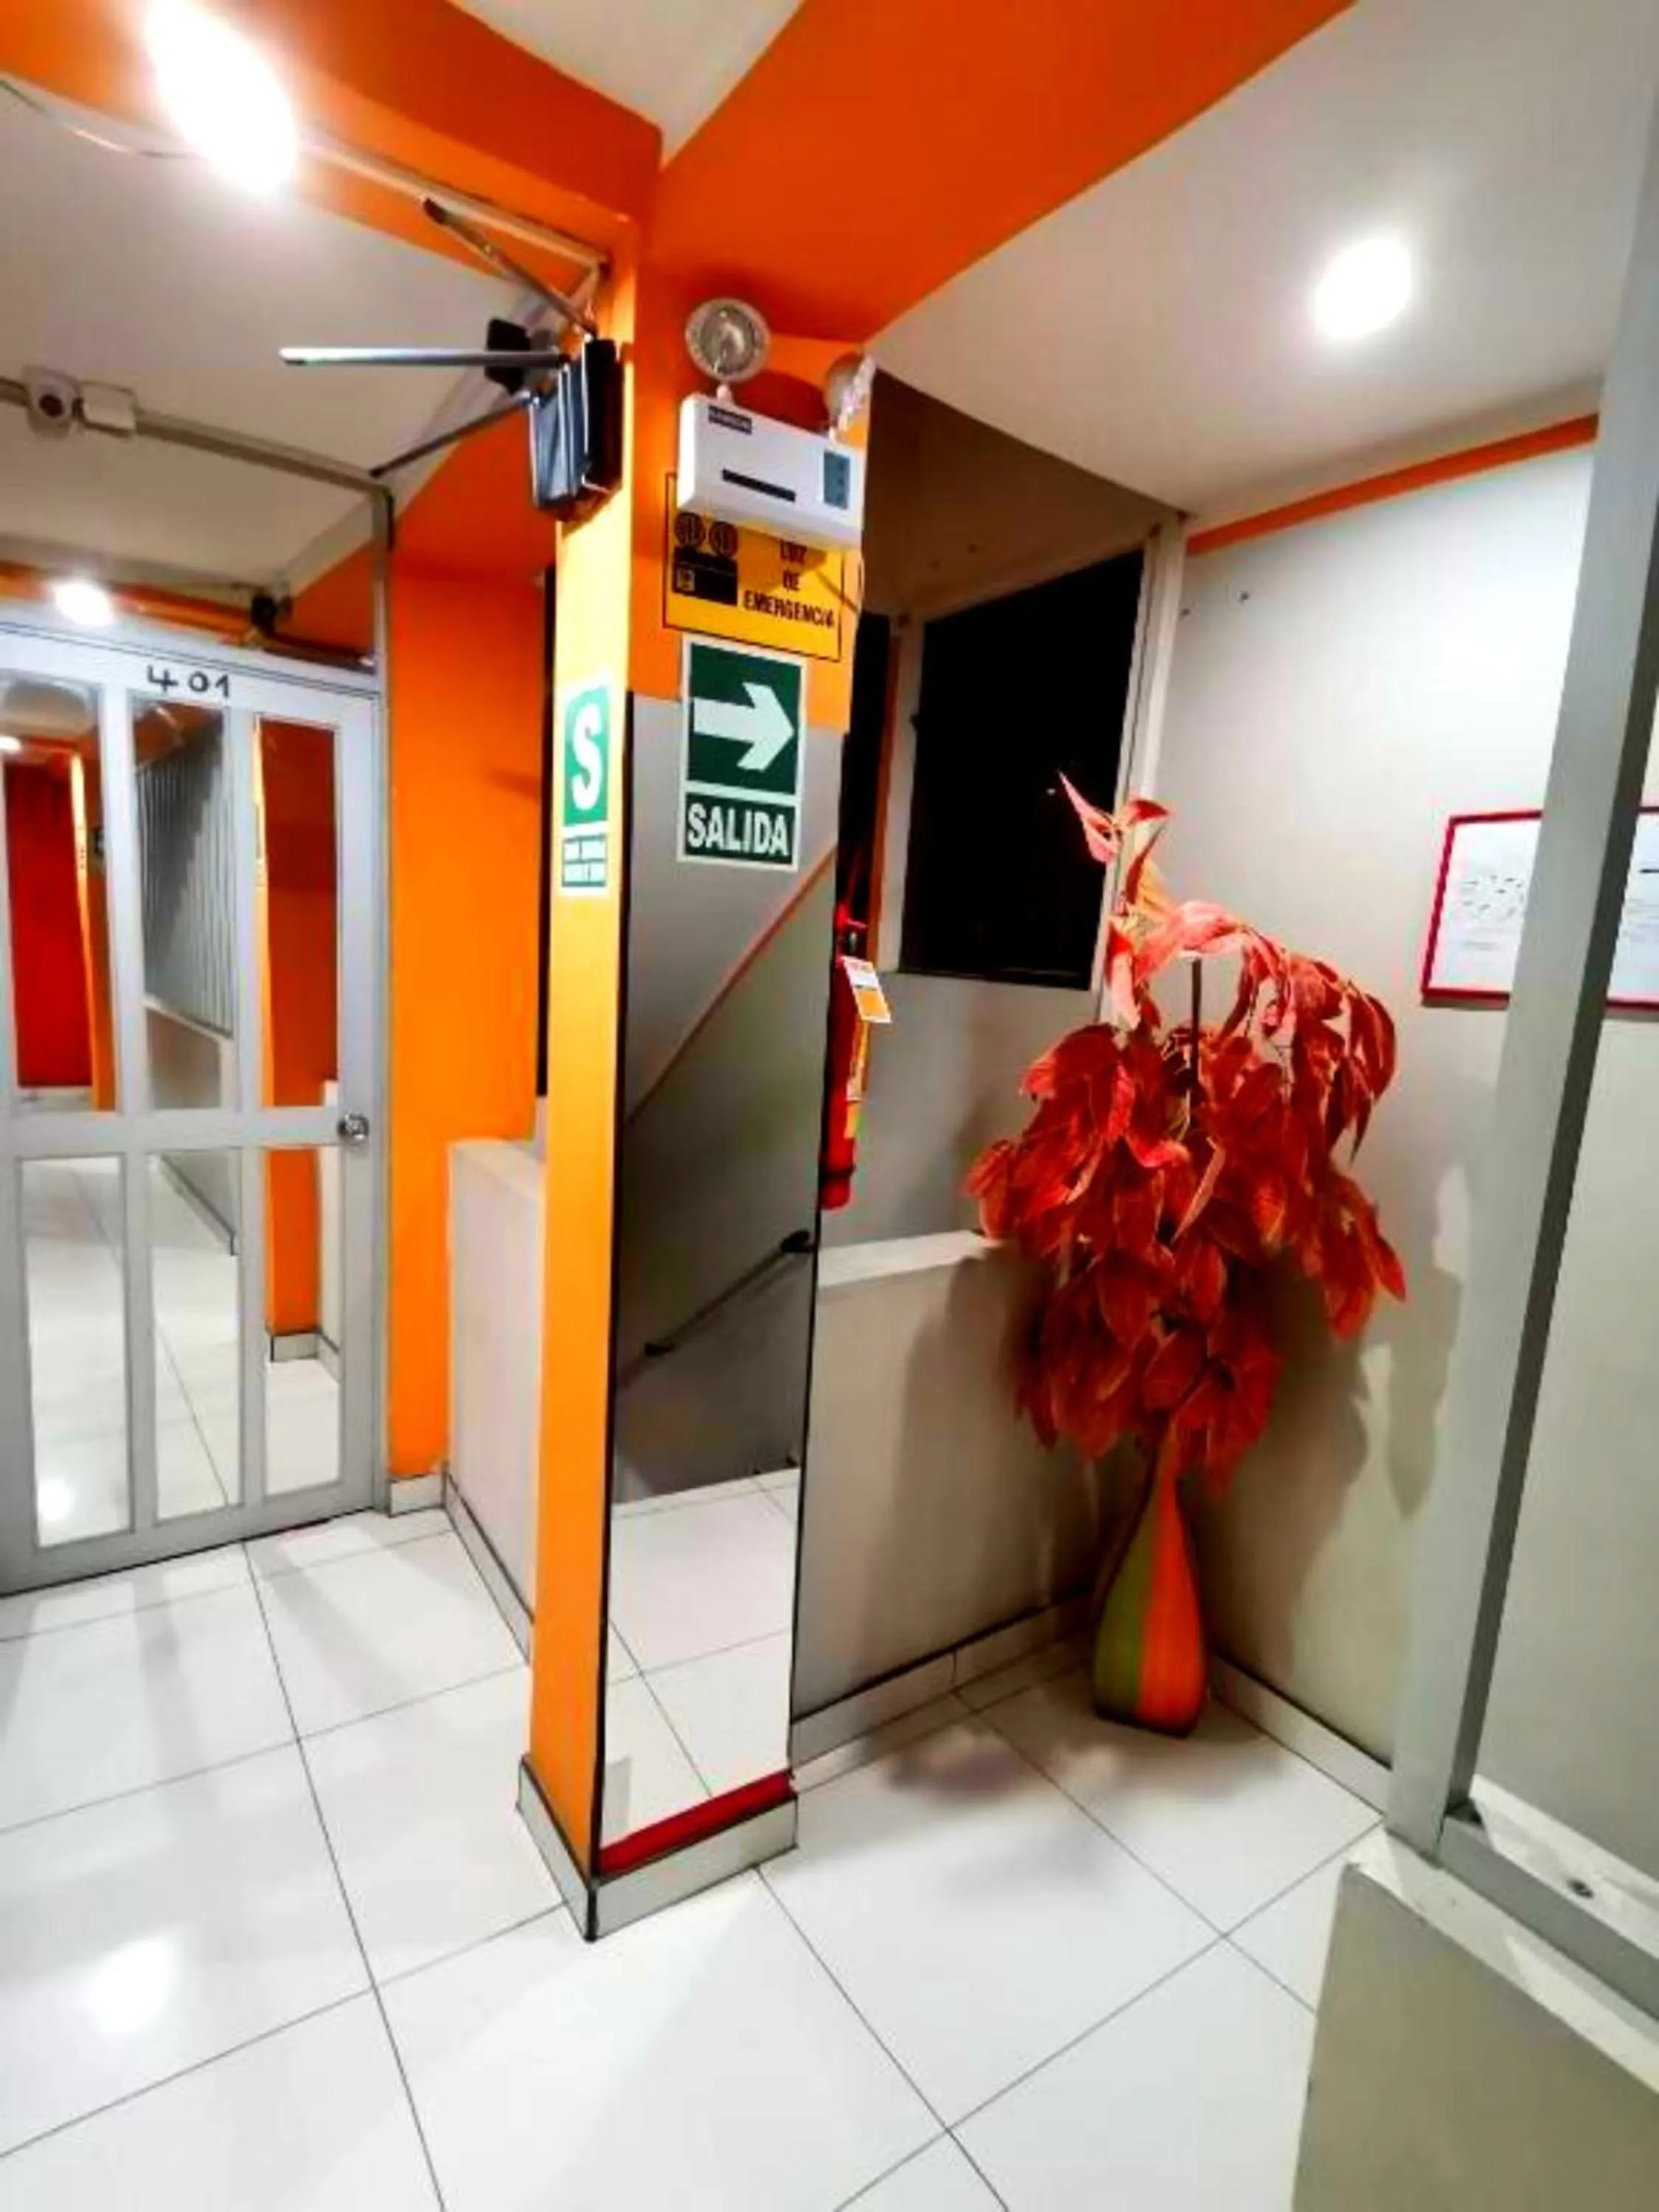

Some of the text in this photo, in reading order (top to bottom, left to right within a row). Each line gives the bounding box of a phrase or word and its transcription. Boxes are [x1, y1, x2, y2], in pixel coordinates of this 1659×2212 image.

[743, 589, 834, 627] EMERGENCIA
[147, 665, 230, 698] 401
[572, 702, 602, 810] S
[687, 802, 789, 856] SALIDA
